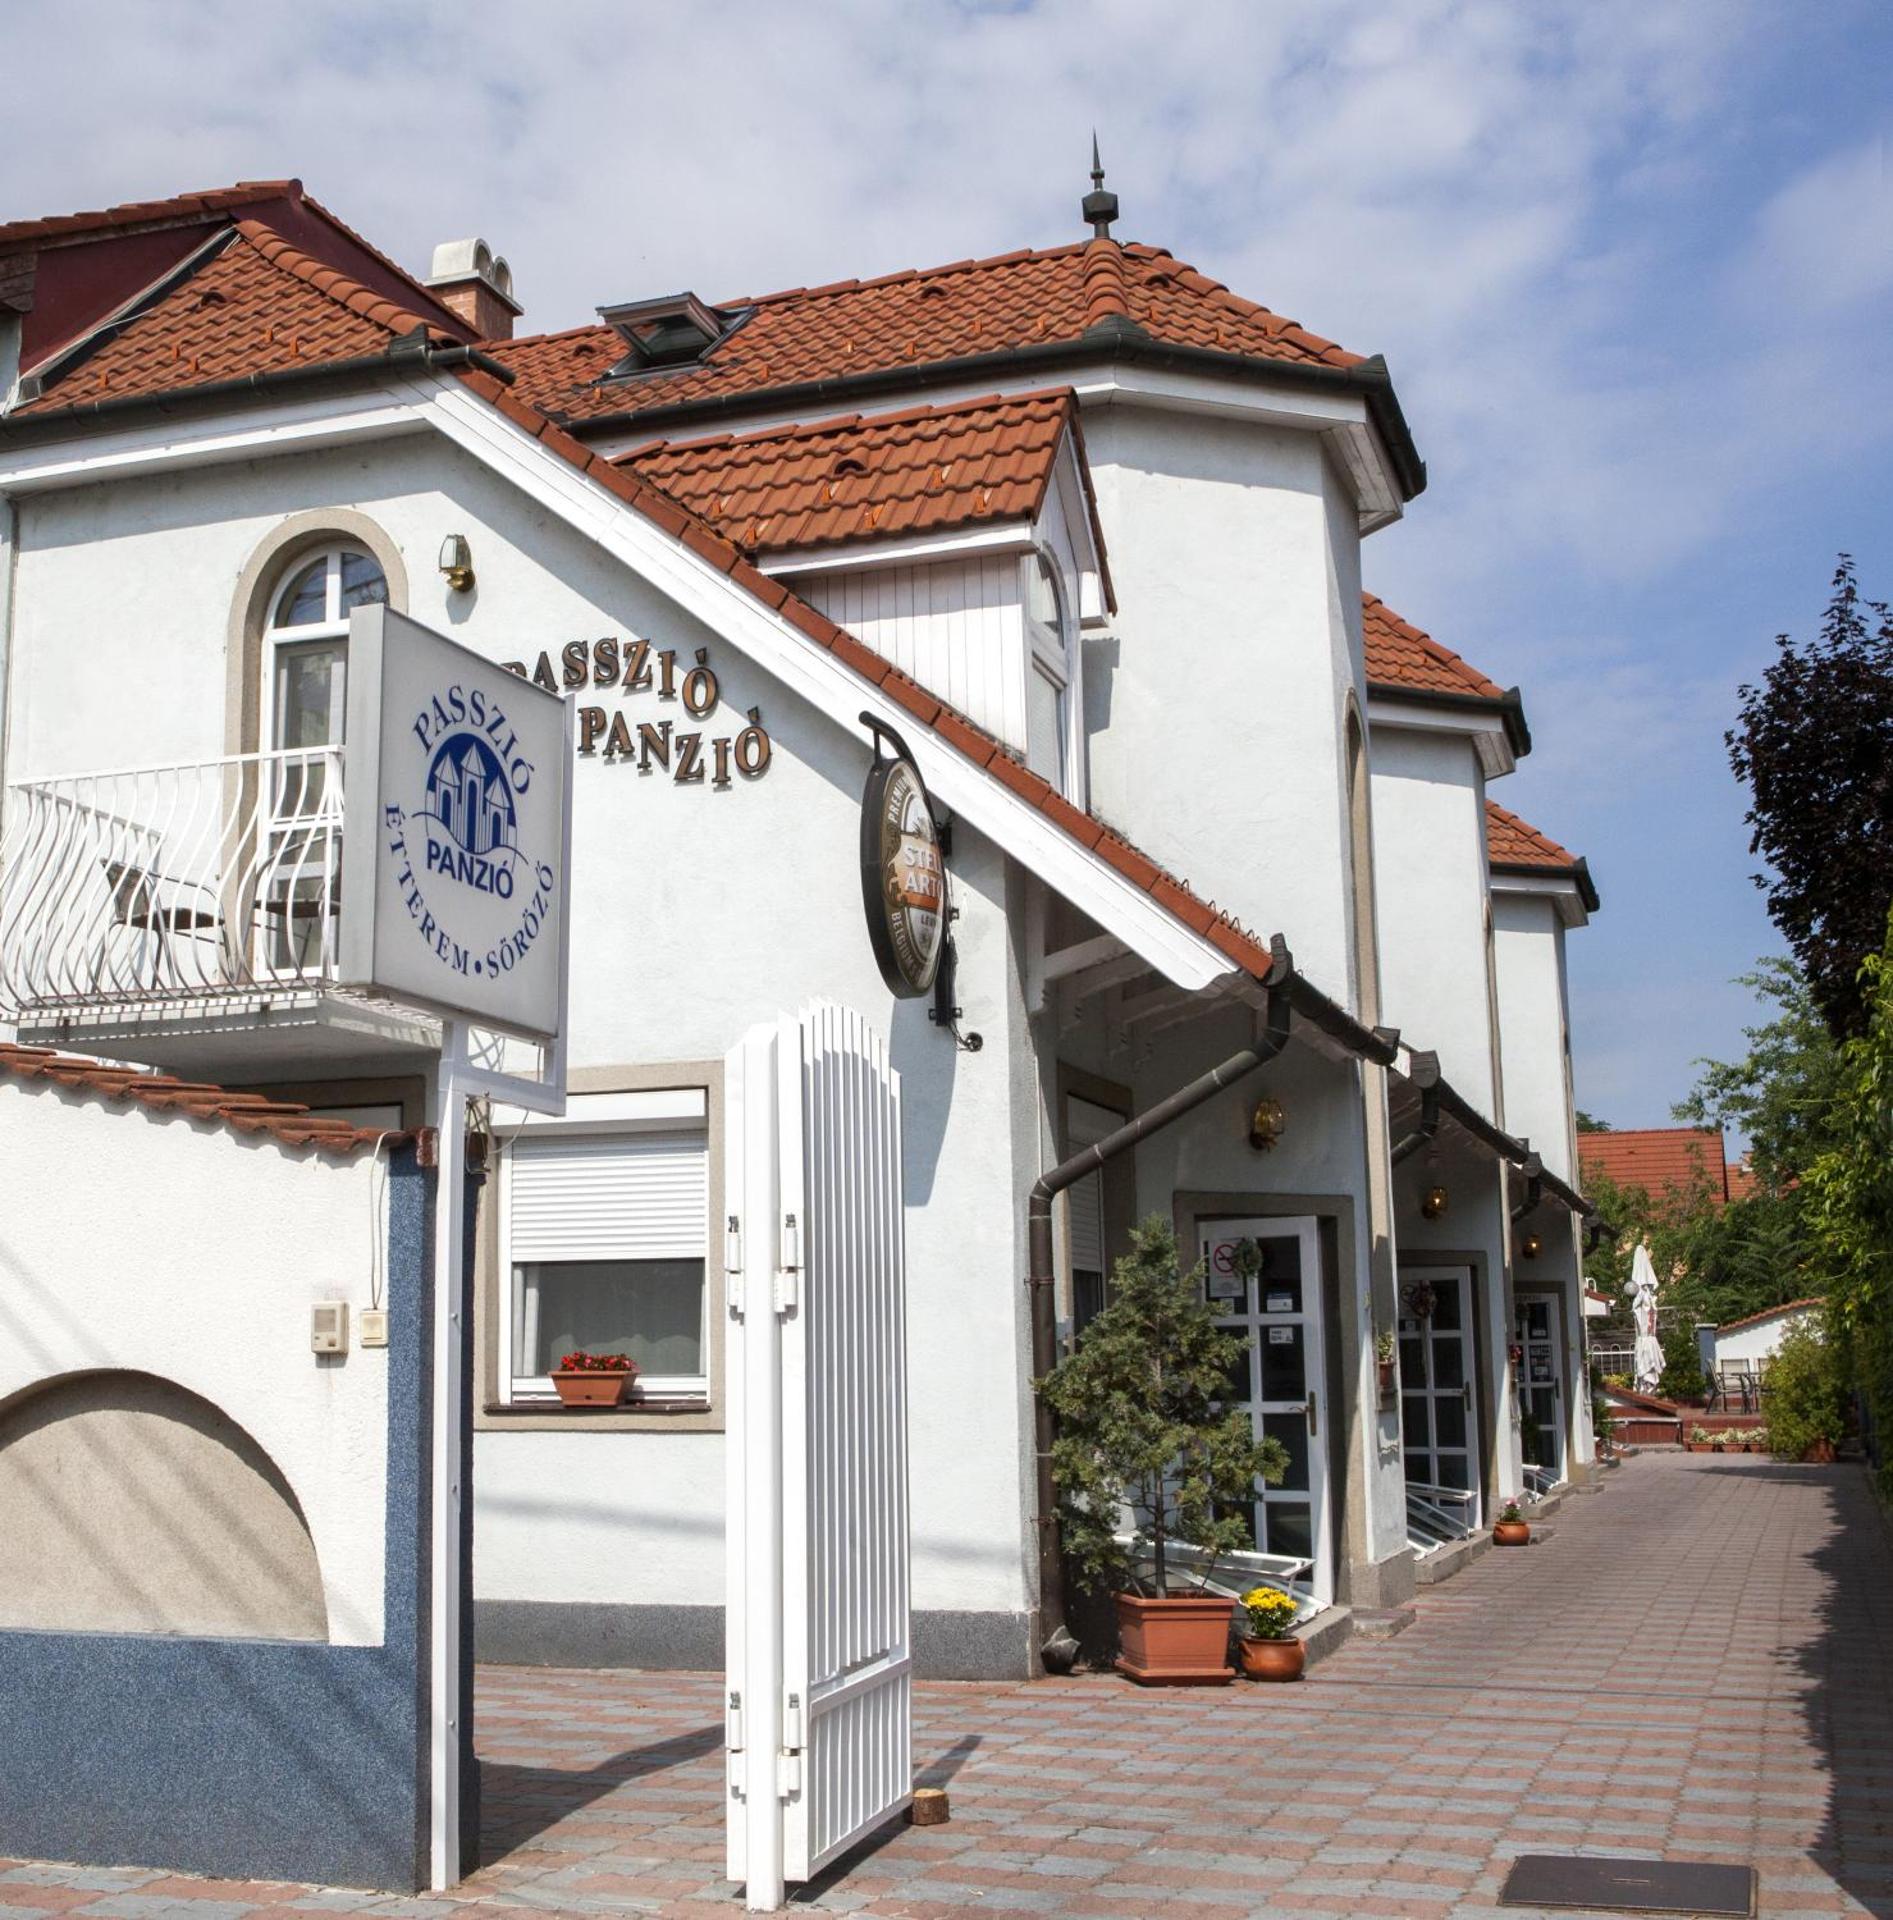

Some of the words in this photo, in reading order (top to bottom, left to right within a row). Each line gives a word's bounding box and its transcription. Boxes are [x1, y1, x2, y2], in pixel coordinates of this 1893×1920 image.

[412, 683, 535, 795] PASSZIÓ
[577, 706, 772, 784] PANZIÓ
[385, 803, 470, 977] ÉTTEREM
[486, 860, 554, 980] SÖRÖZŐ
[427, 838, 514, 899] PANZIÓ
